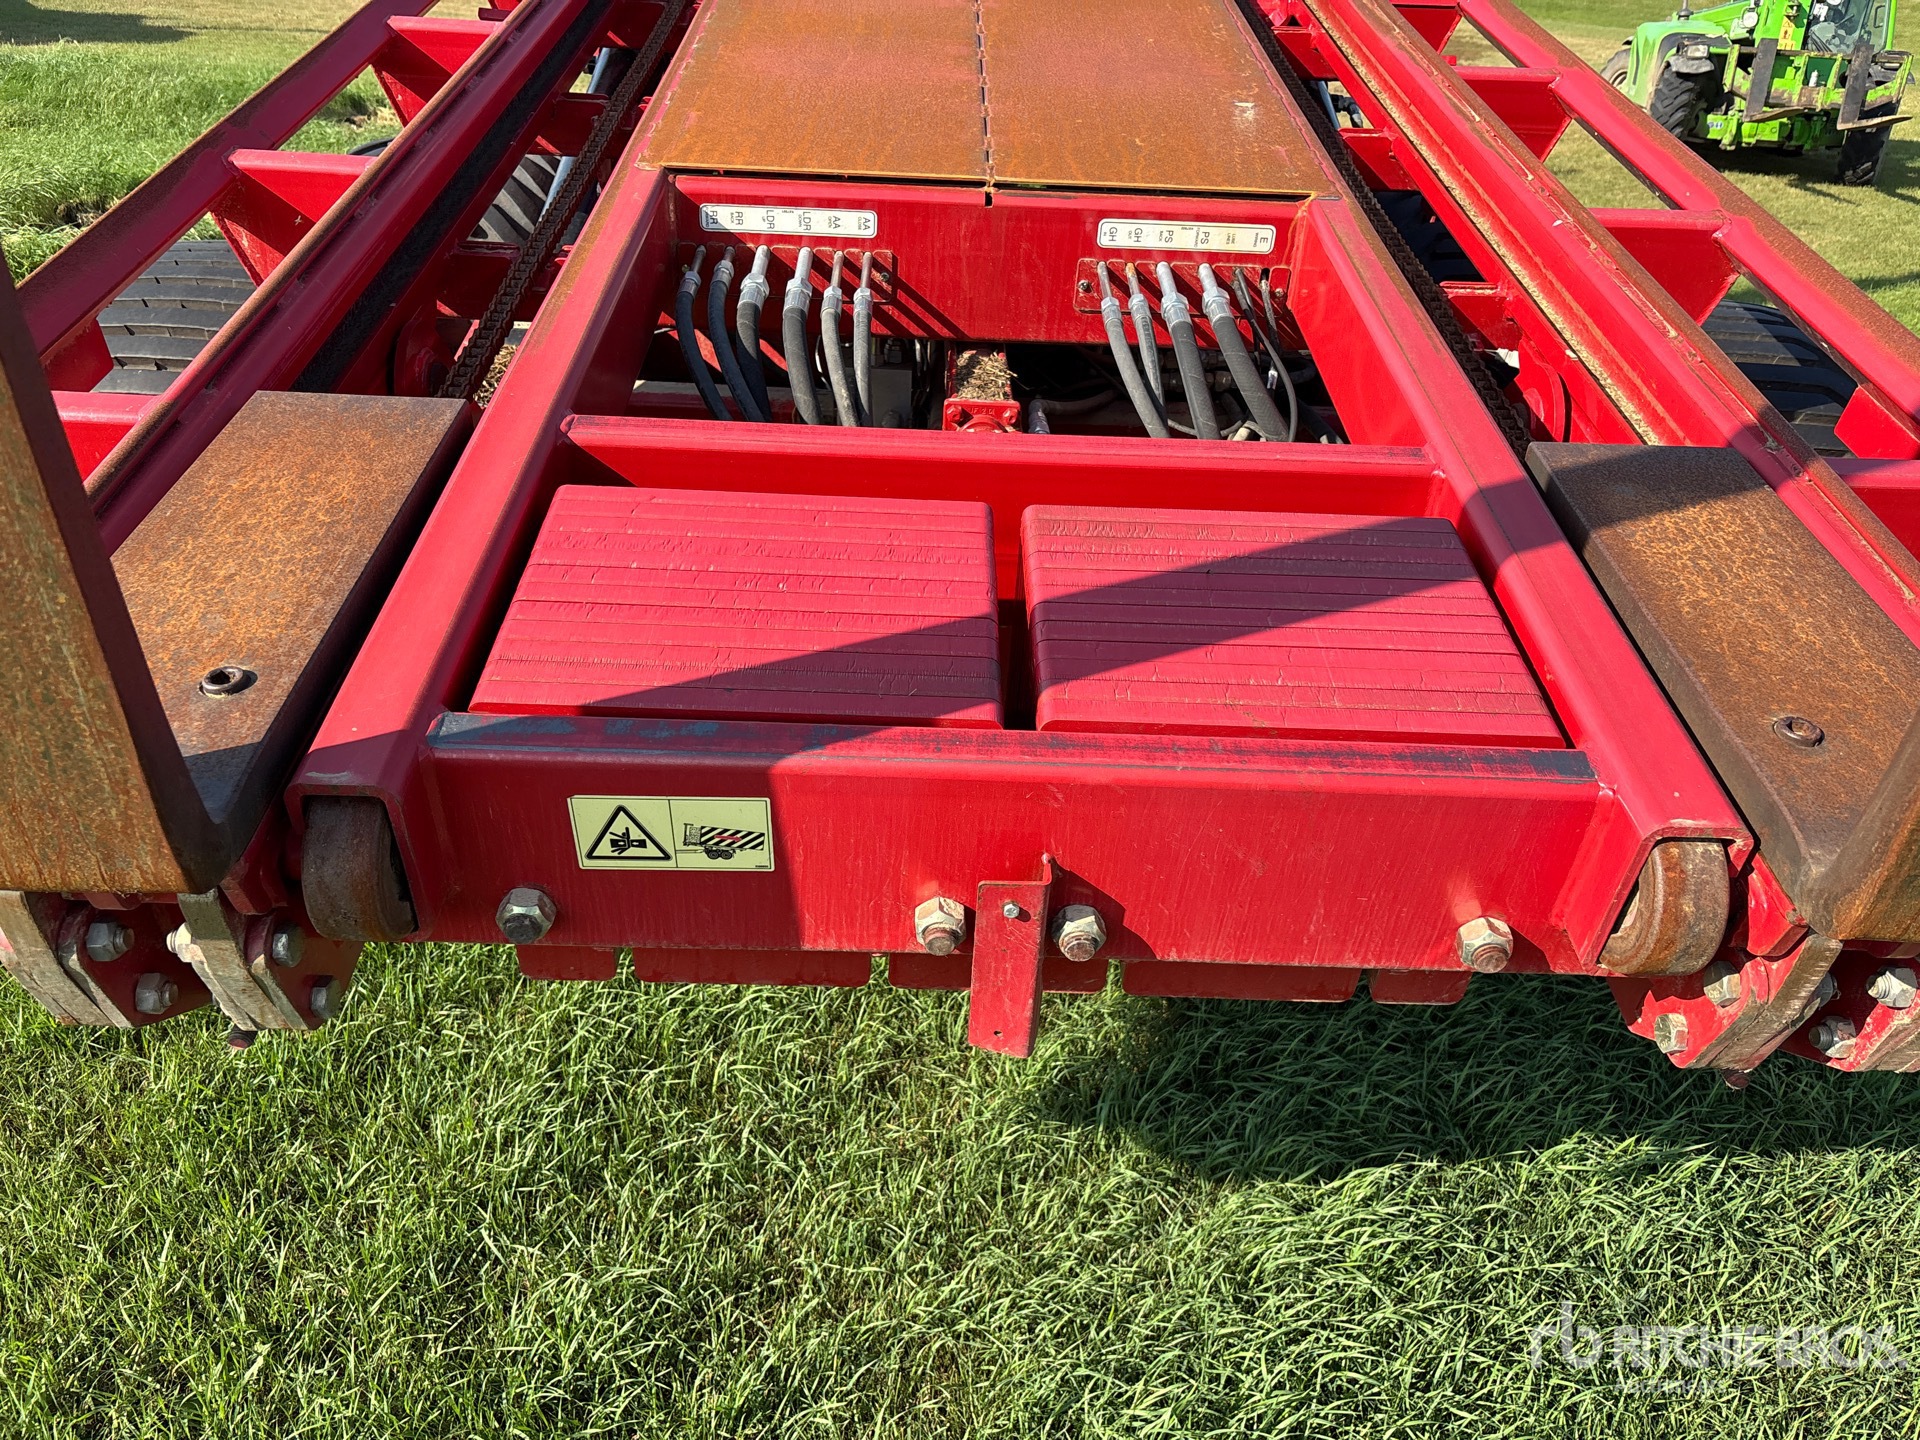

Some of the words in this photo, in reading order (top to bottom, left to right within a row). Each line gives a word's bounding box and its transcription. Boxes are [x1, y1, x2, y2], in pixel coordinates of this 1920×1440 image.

[709, 210, 718, 226] RR
[735, 211, 744, 226] RR
[766, 209, 775, 231] LDR
[802, 211, 812, 232] LDR
[832, 215, 841, 230] AA
[862, 216, 871, 231] AA
[1108, 226, 1118, 242] GH
[1133, 227, 1143, 243] GH
[1164, 229, 1174, 243] PS
[1201, 231, 1210, 245] PS
[1259, 236, 1268, 244] E
